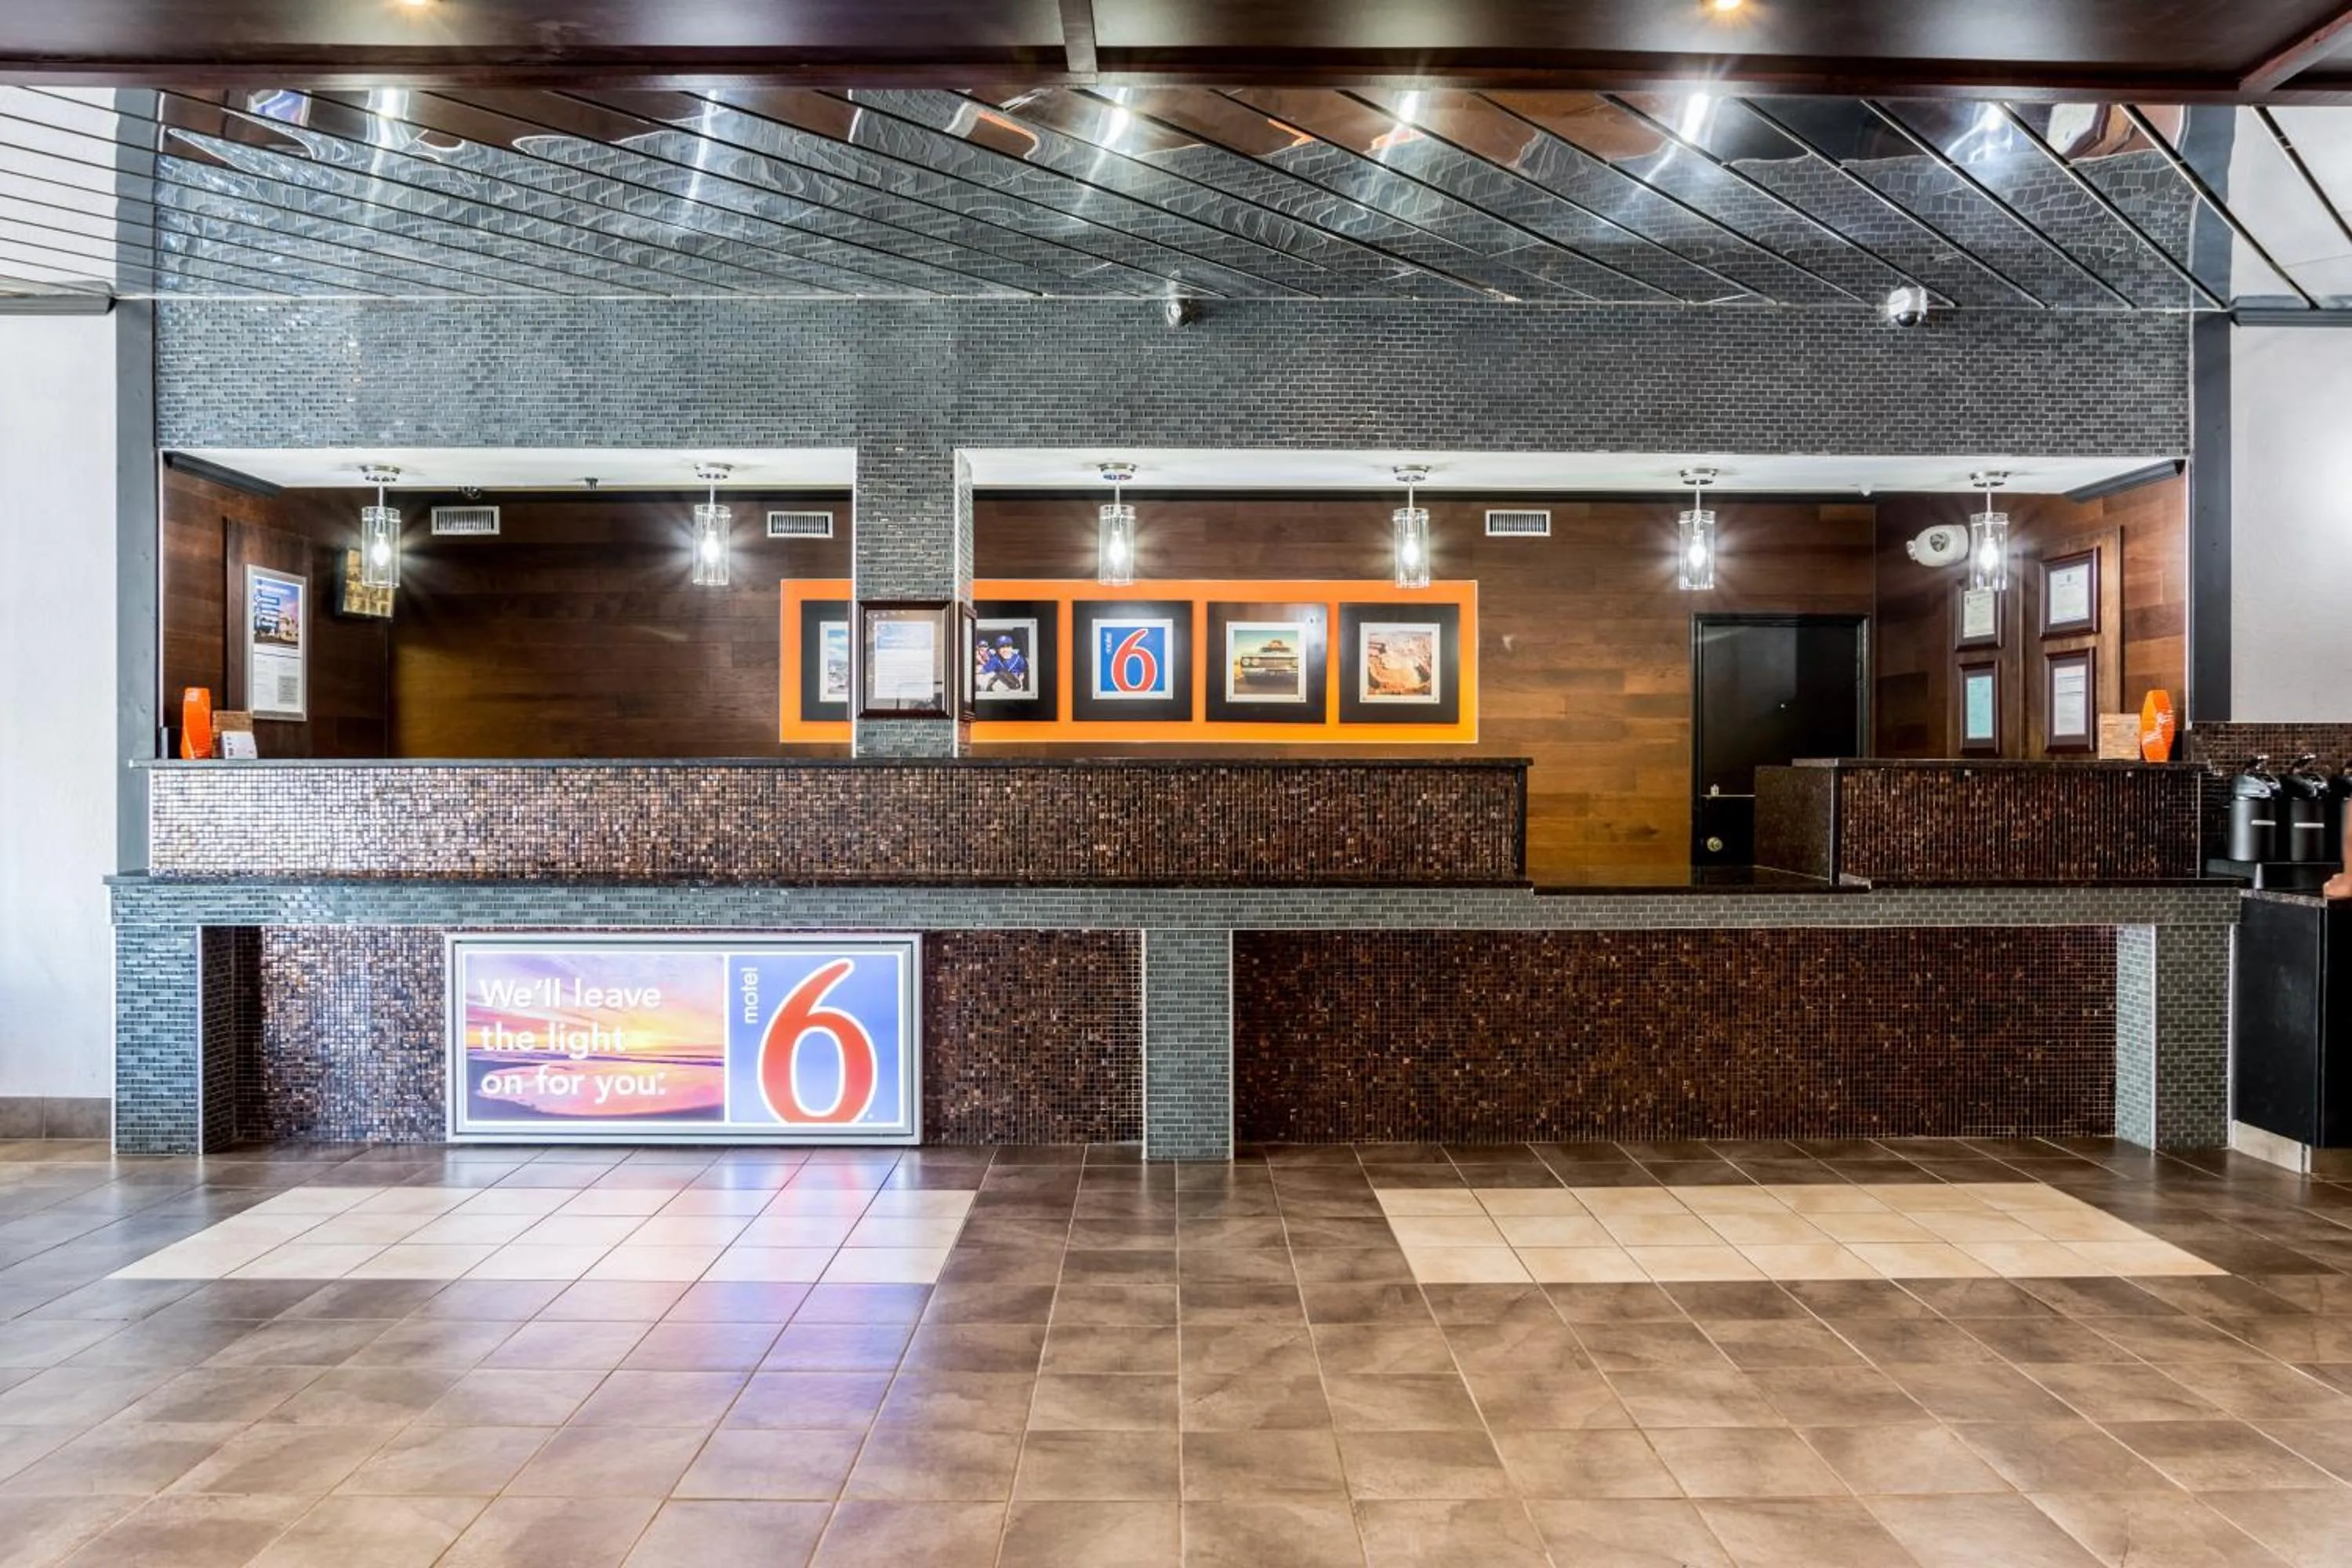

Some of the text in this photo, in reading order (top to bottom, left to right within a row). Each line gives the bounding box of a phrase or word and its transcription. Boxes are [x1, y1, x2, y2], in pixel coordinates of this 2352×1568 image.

[1111, 628, 1158, 692] 6
[480, 978, 661, 1008] We'll leave
[740, 967, 759, 1025] motel
[480, 1021, 627, 1059] the light
[757, 957, 878, 1123] 6
[481, 1071, 523, 1095] on
[535, 1065, 585, 1095] for
